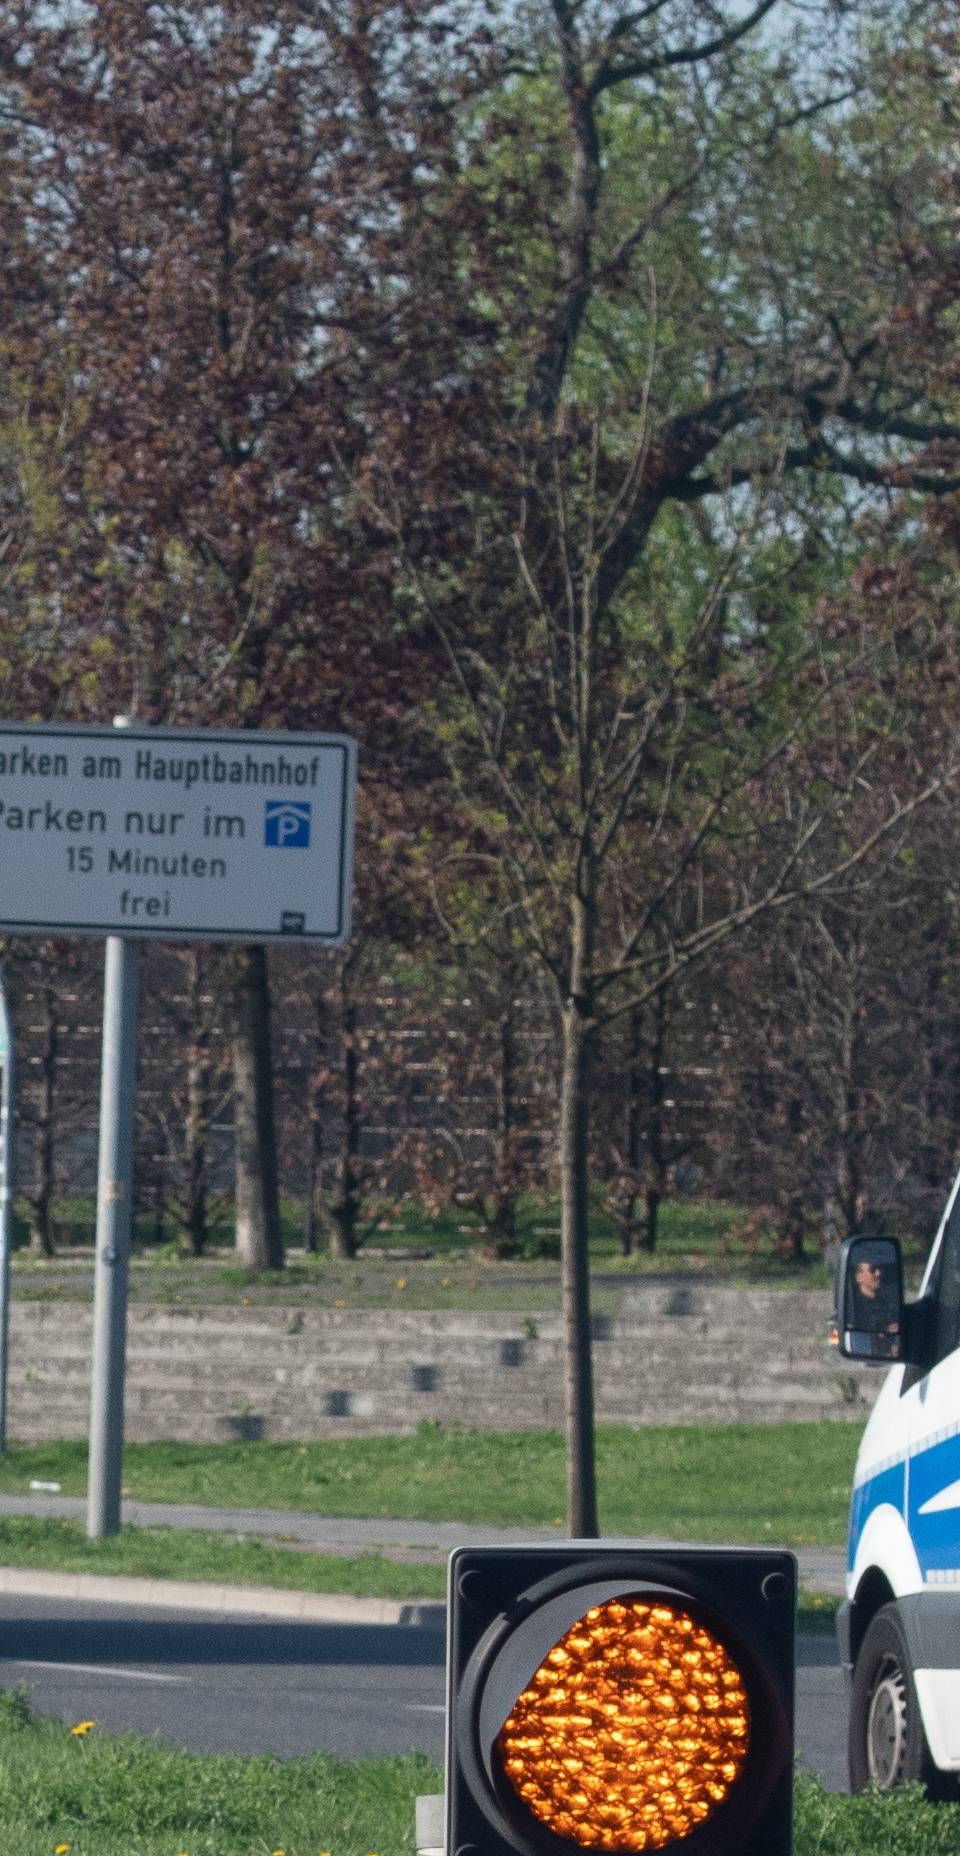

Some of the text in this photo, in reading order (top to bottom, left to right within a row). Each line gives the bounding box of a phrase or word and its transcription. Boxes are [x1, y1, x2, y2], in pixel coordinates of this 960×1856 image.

[82, 754, 121, 778] am
[135, 750, 320, 788] Hauptbahnhof
[0, 800, 107, 832] arken
[124, 810, 185, 834] nur
[204, 806, 246, 837] im
[67, 847, 226, 878] 15 Minuten
[120, 889, 171, 917] frei
